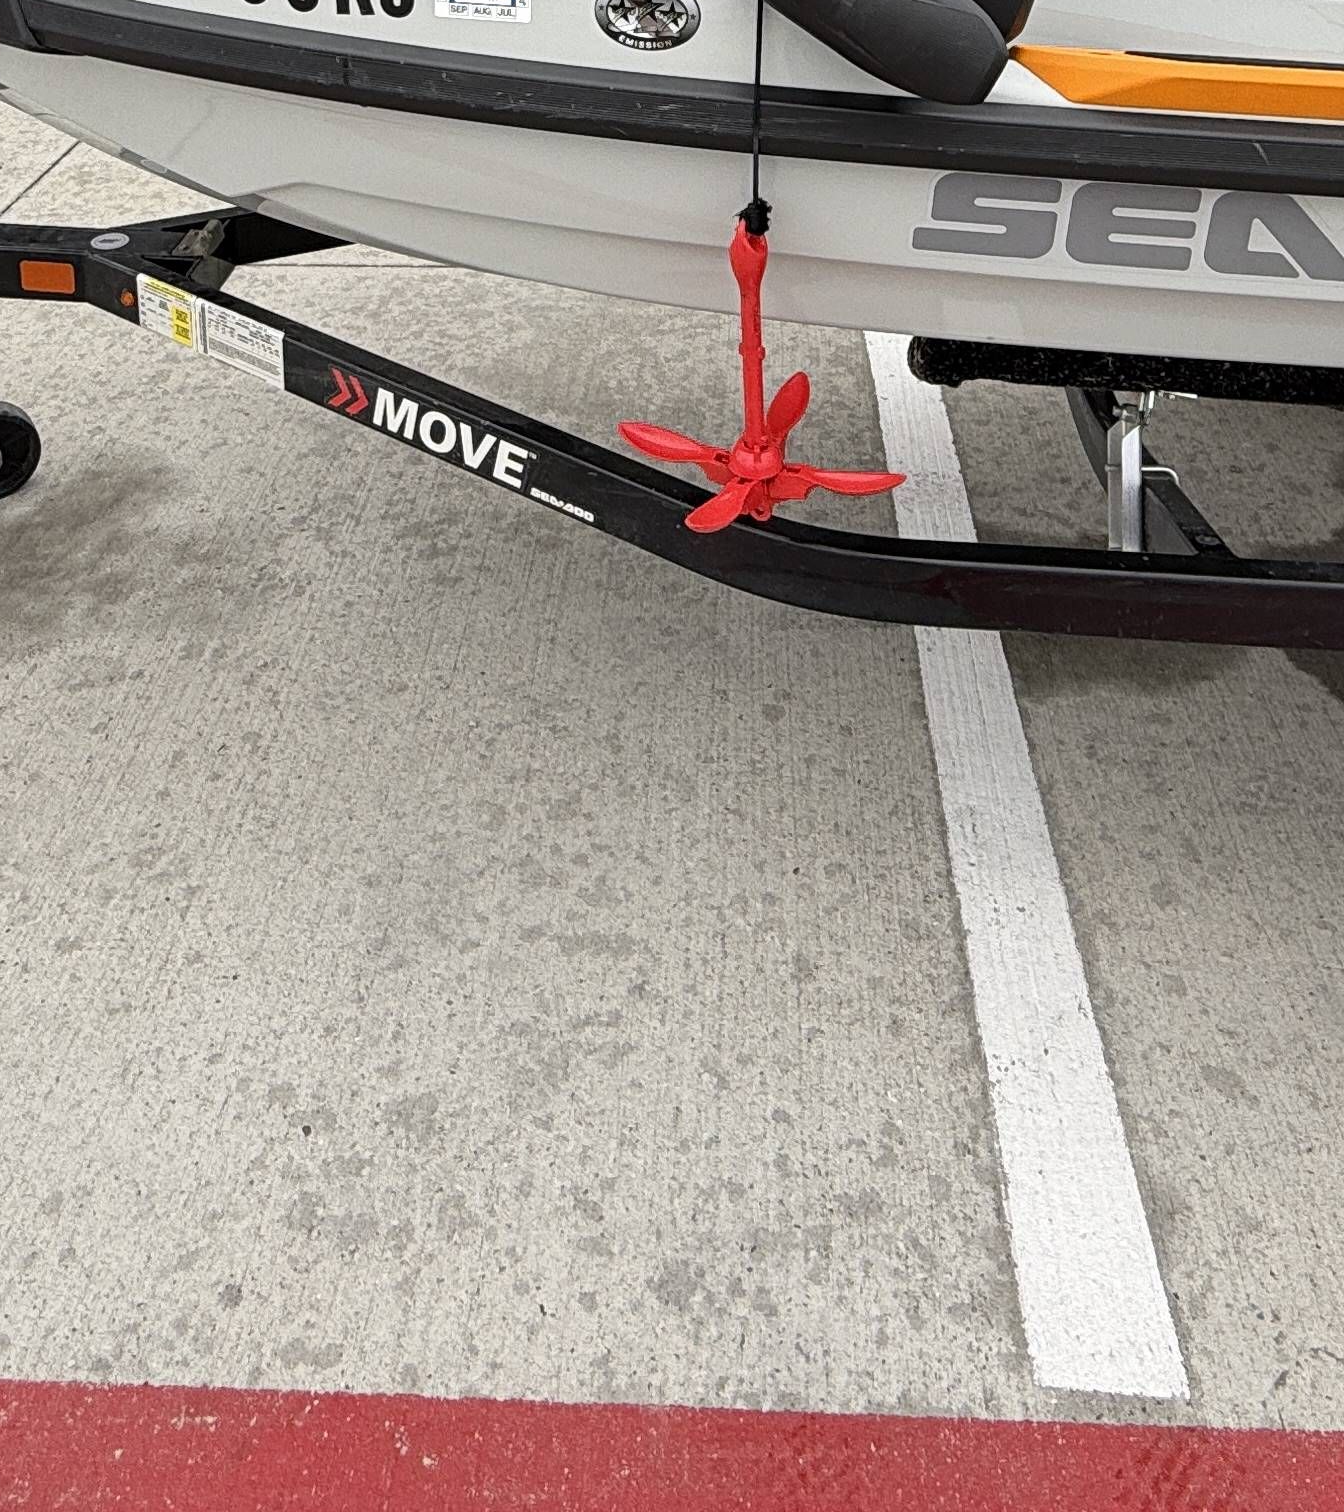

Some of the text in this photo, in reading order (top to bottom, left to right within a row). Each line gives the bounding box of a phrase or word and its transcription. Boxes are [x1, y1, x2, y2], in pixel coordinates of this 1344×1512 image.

[451, 5, 514, 16] SEP AUG JUL
[618, 34, 673, 49] EMISSION
